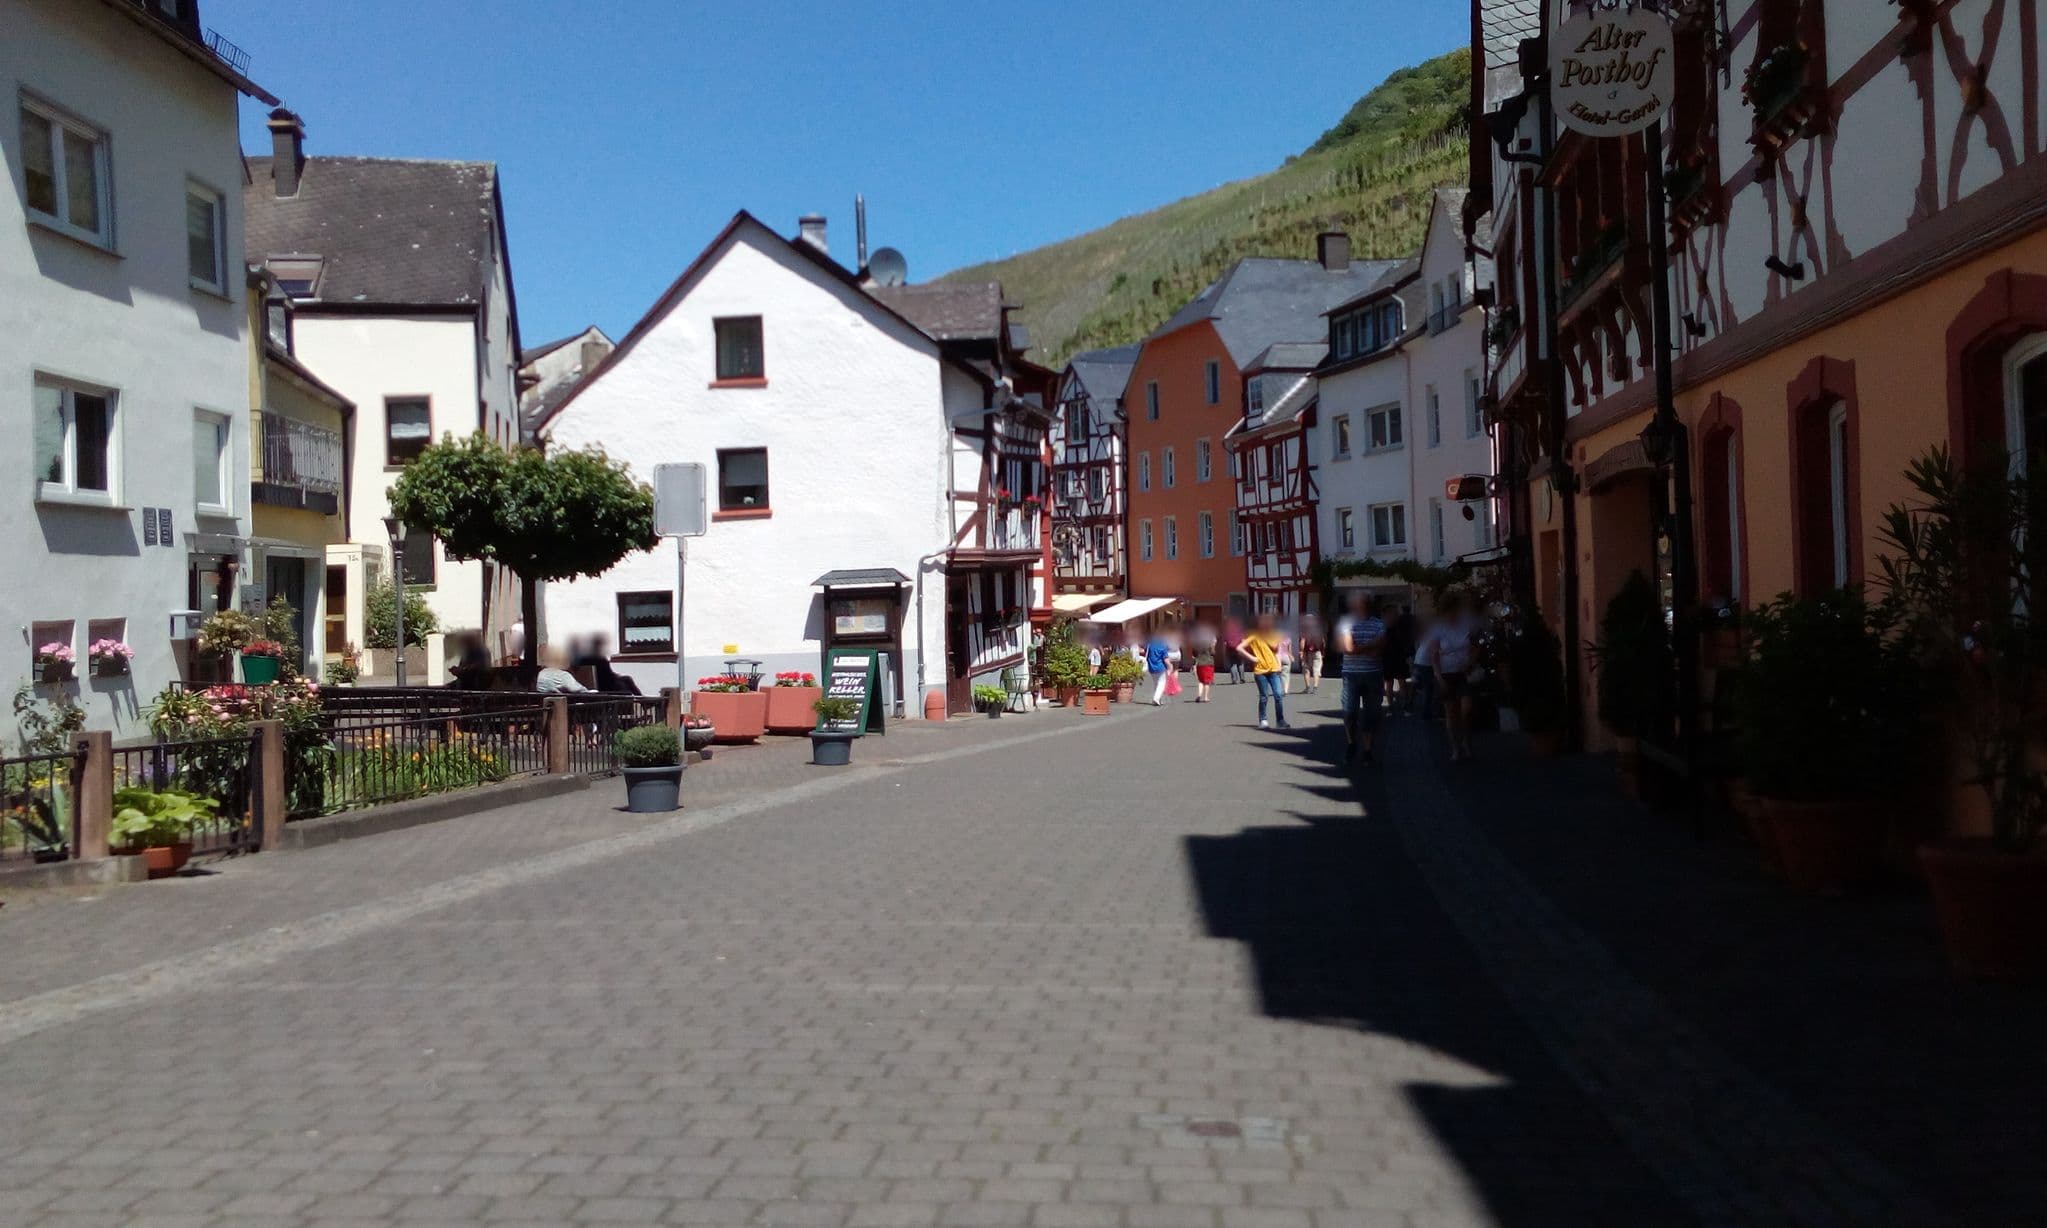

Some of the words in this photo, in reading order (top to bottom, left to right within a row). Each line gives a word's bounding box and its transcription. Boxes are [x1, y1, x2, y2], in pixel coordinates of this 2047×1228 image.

[1574, 23, 1647, 54] Alter
[1559, 48, 1666, 91] Posthof
[1567, 93, 1662, 126] Hotel-Garni
